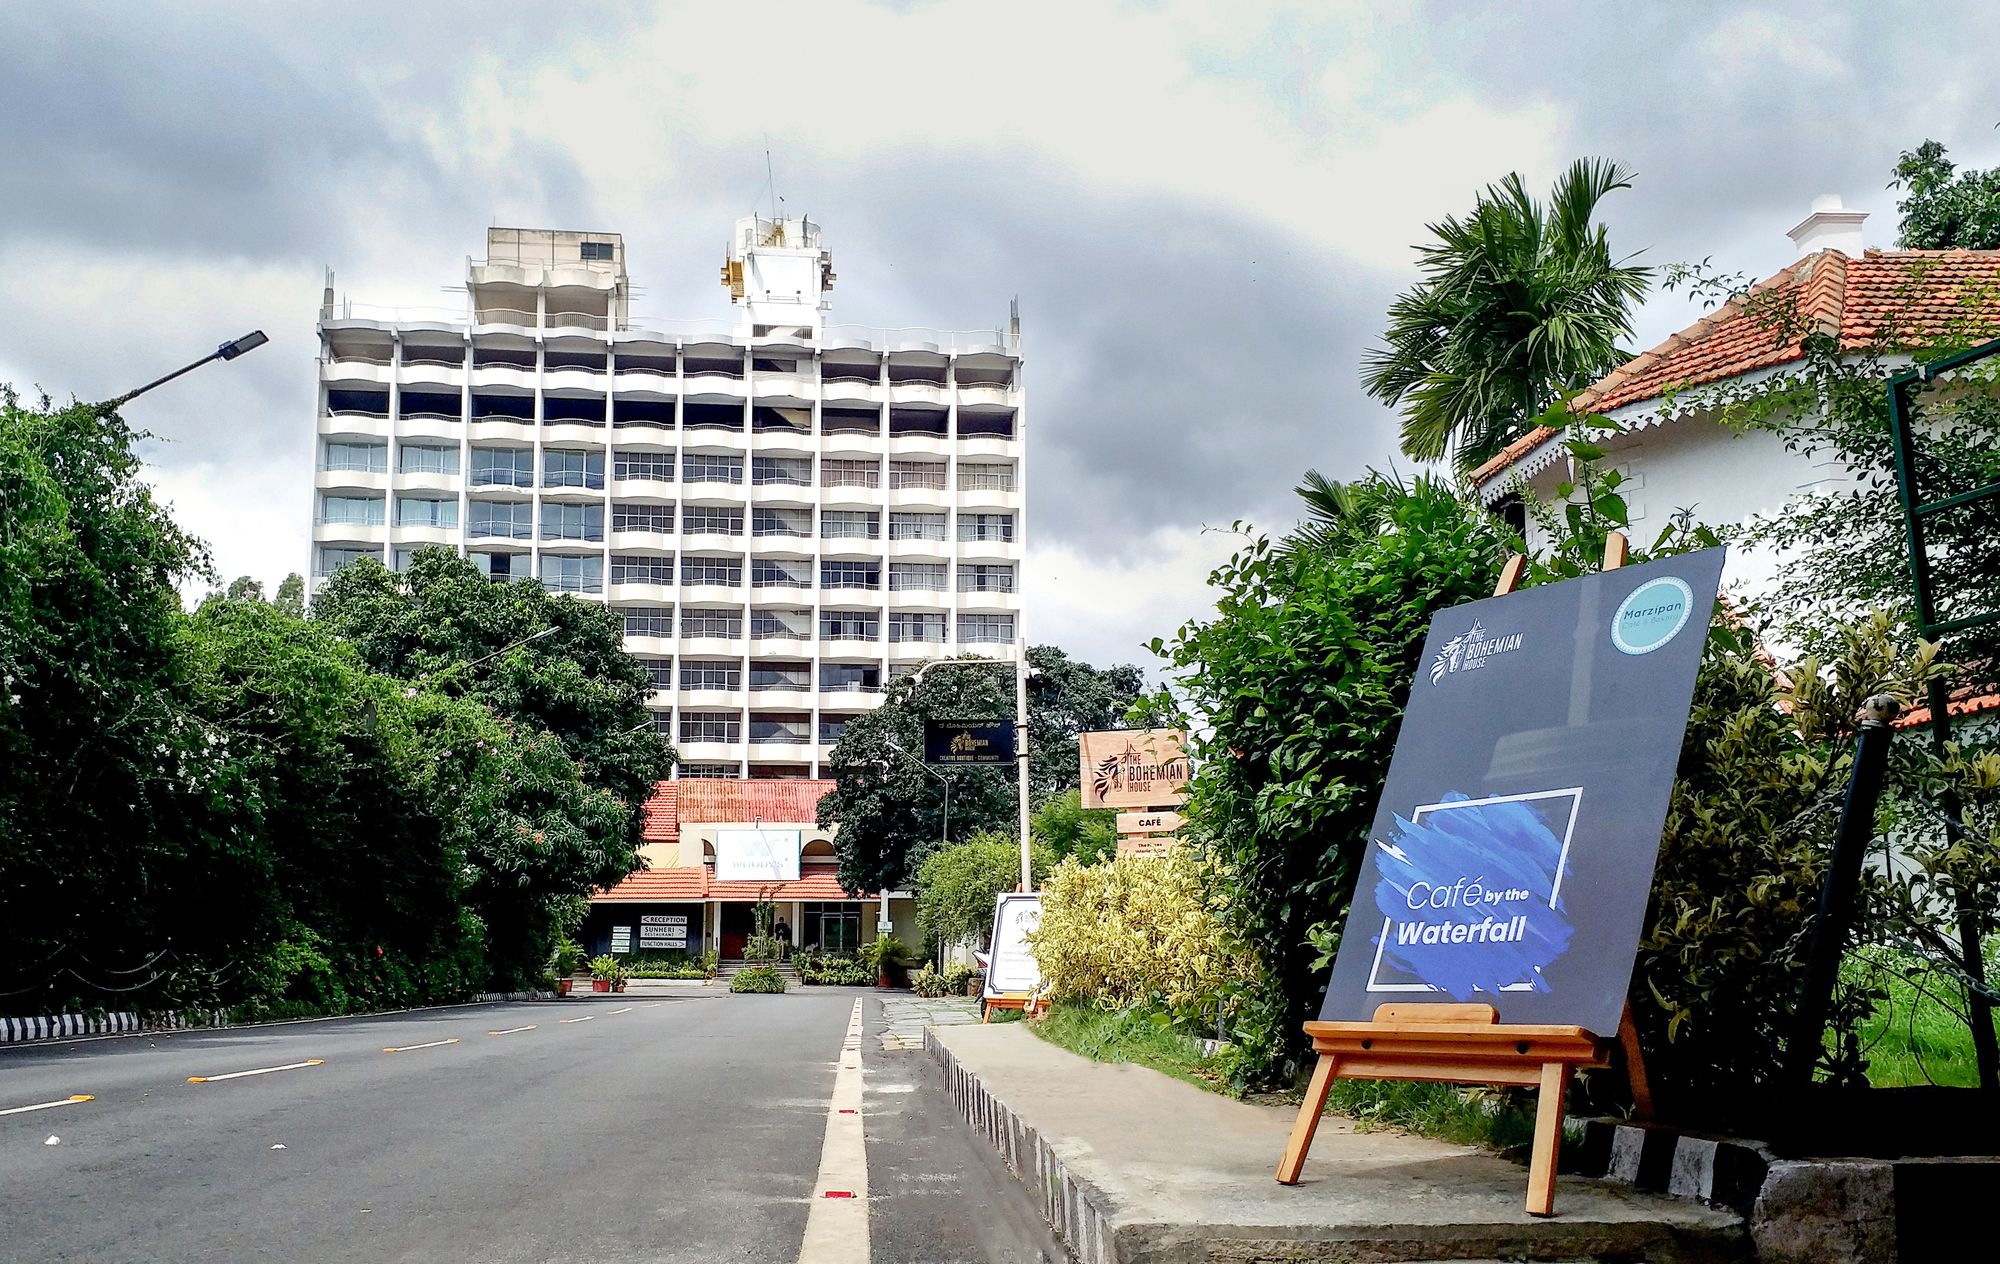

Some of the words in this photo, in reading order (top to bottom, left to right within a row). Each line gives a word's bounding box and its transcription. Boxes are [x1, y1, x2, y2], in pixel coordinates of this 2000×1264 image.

[1623, 602, 1682, 620] Marzipan
[1471, 630, 1486, 643] THE
[1466, 633, 1524, 660] BOHEMIAN
[1463, 656, 1487, 671] HOUSE
[1129, 754, 1141, 765] THE
[1129, 764, 1183, 781] BOHEMIAN
[1129, 781, 1151, 793] HOUSE
[1138, 817, 1161, 827] CAFÉ
[1406, 876, 1483, 910] Café
[1484, 889, 1503, 905] by
[1505, 888, 1529, 901] the
[1397, 915, 1527, 945] Waterfall
